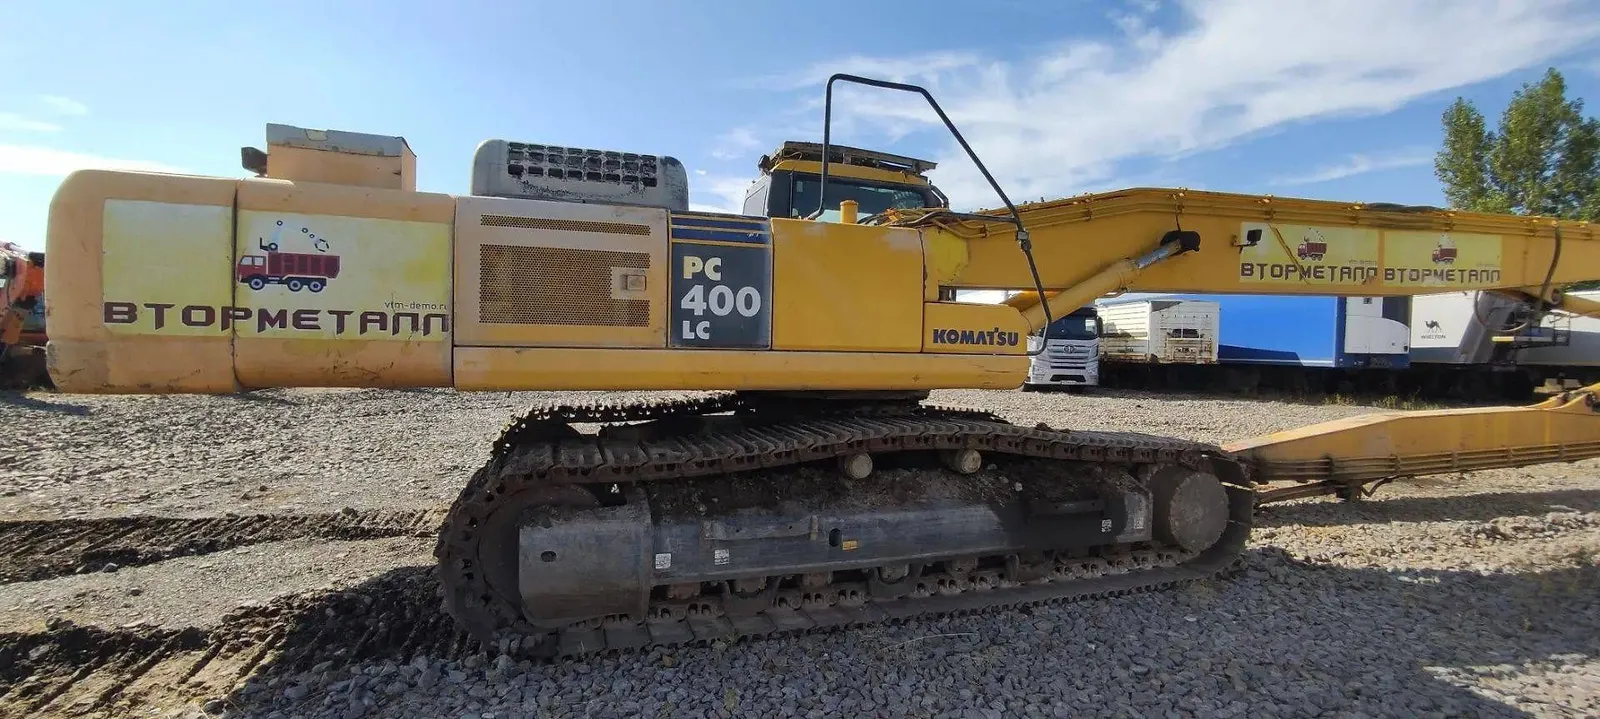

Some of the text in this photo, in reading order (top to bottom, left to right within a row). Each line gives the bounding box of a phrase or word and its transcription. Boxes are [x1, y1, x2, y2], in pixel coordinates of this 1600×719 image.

[683, 256, 722, 280] PC
[681, 284, 761, 317] 400
[682, 320, 710, 340] LC
[933, 327, 1019, 347] KOMATSU
